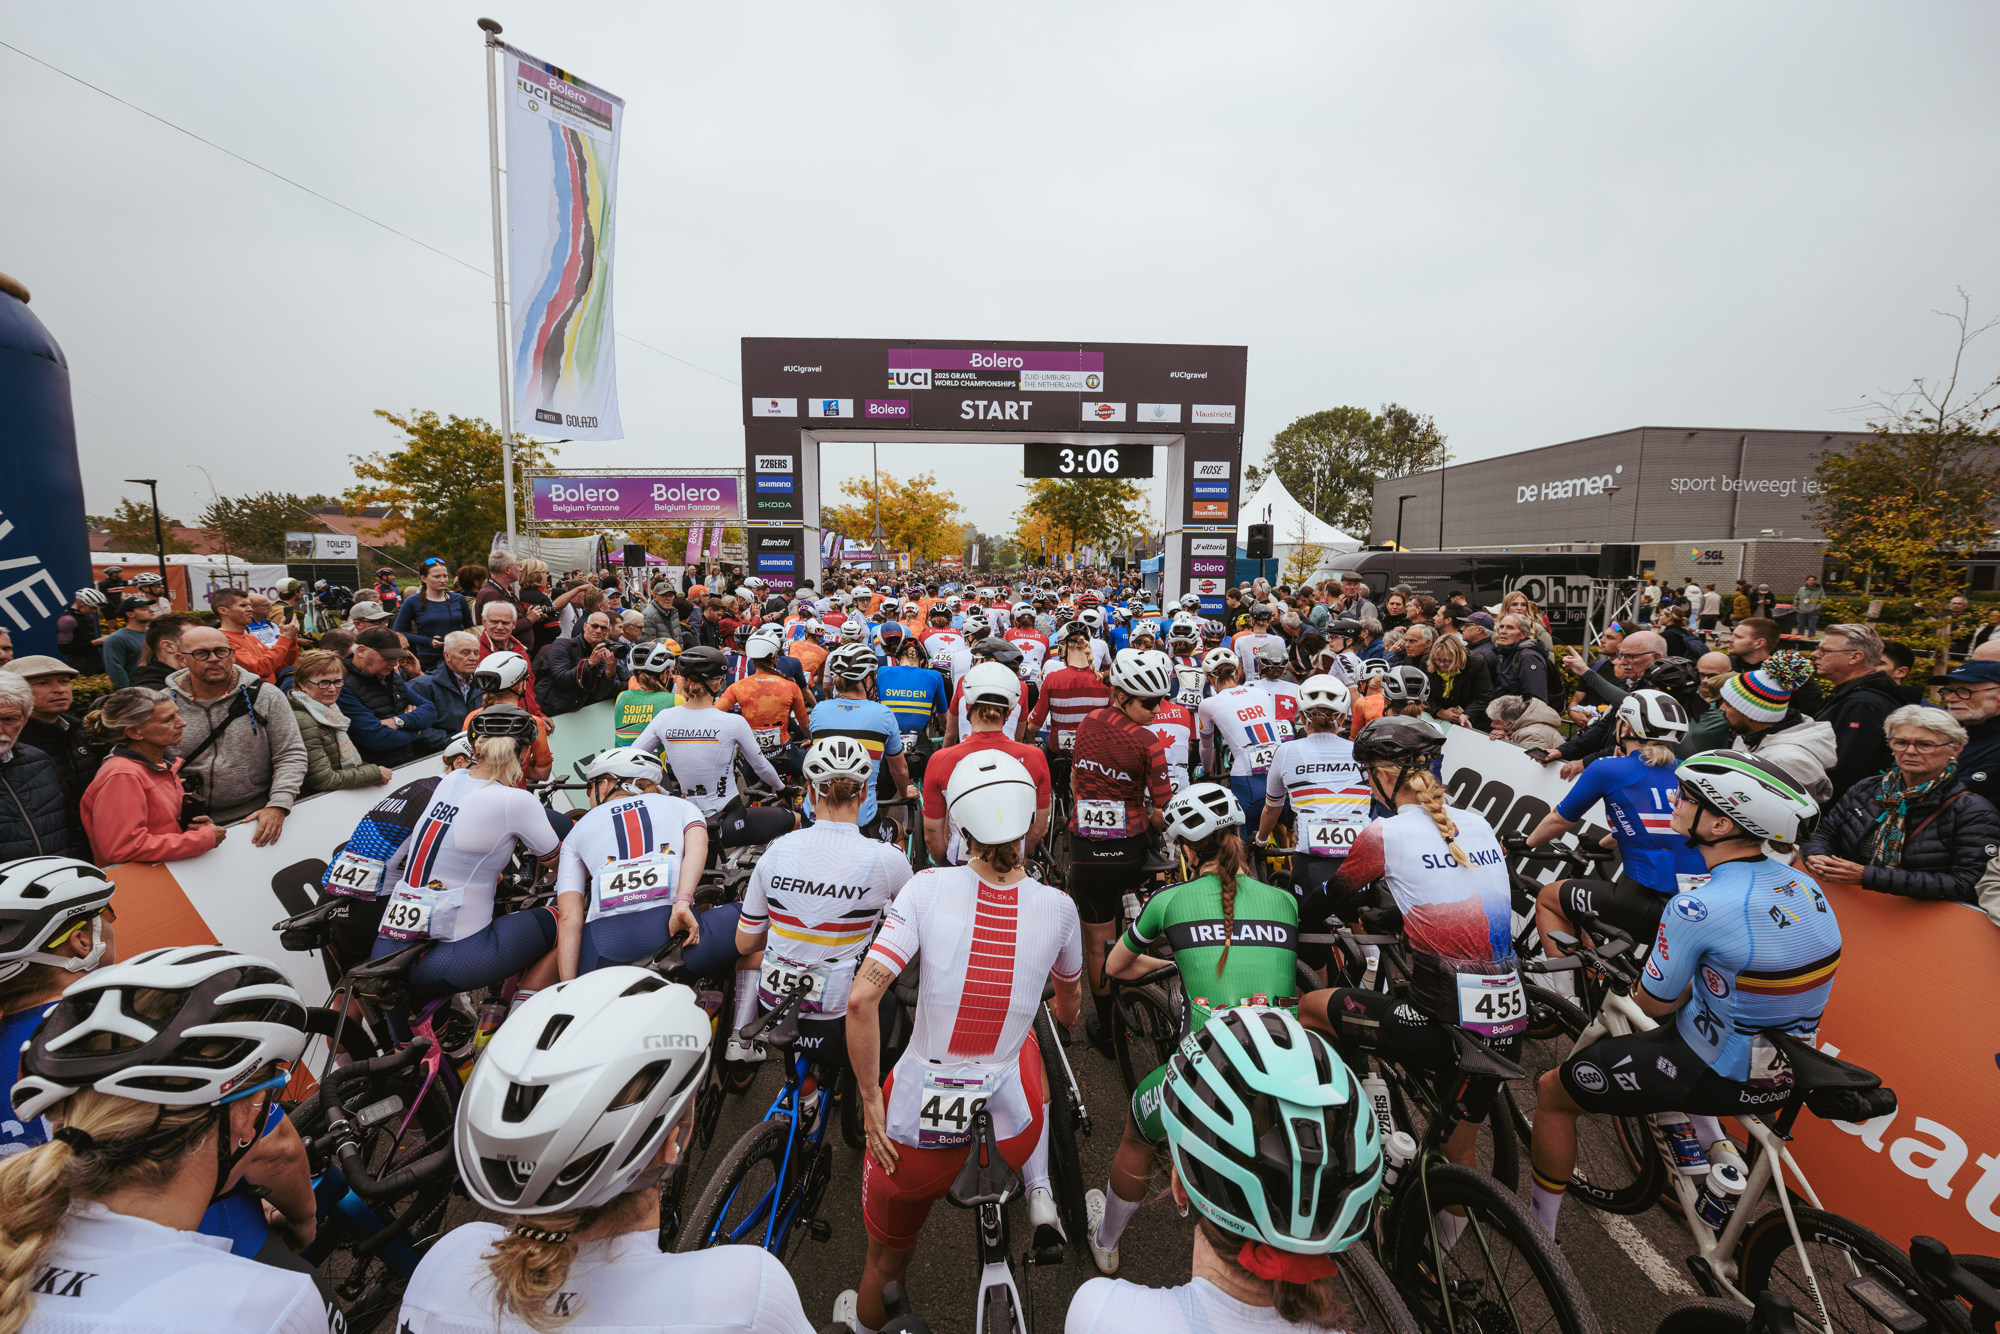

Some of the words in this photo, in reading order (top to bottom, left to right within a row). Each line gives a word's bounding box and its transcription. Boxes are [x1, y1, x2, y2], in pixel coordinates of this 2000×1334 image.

[522, 82, 548, 101] UCI
[547, 78, 587, 104] Bolero
[571, 108, 610, 129] CHAMPIONSHIPS
[969, 353, 1024, 368] Bolero
[783, 365, 822, 374] #UCIgravel
[1170, 371, 1208, 379] #UCIgravel
[896, 372, 928, 386] UCI
[960, 380, 1016, 388] CHAMPIONSHIPS
[868, 404, 905, 415] Bolero
[960, 400, 1033, 420] START
[1195, 410, 1232, 418] Maastricht
[566, 415, 598, 428] GOLAZO
[760, 459, 787, 469] 226ERS
[1058, 448, 1119, 473] 3:06
[1200, 465, 1224, 475] ROSE
[548, 483, 620, 502] Bolero
[650, 483, 721, 501] Bolero
[1670, 475, 1716, 494] sport
[1721, 475, 1797, 497] beweegt
[552, 504, 585, 513] Belgium
[586, 504, 620, 512] Fanzone
[654, 503, 686, 513] Belgium
[687, 503, 721, 511] Fanzone
[689, 520, 699, 545] Bole
[326, 540, 352, 549] TOILETS
[761, 538, 791, 546] Santini
[1704, 550, 1724, 560] SGL
[1193, 563, 1224, 572] Bolero
[1553, 611, 1560, 619] &
[1568, 610, 1586, 622] ligh
[1014, 632, 1041, 640] Canada
[885, 688, 927, 699] SWEDEN
[1180, 693, 1201, 704] 430
[624, 704, 654, 714] SOUTH
[1154, 709, 1182, 720] nada
[1236, 704, 1267, 722] GBR
[622, 714, 653, 724] AFRICA
[665, 728, 721, 738] GERMANY
[755, 735, 776, 746] 437
[1255, 750, 1273, 765] 43
[1074, 758, 1132, 782] ATVIA
[1295, 762, 1364, 775] GERMAN
[430, 801, 460, 823] GBR
[610, 800, 645, 815] GBR
[1168, 799, 1189, 811] KASK
[1696, 778, 1770, 835] SPECIALIZED
[1084, 809, 1117, 827] 443
[1215, 816, 1234, 826] KASK
[1610, 802, 1636, 837] ICELAND
[1316, 827, 1357, 844] 460
[1422, 848, 1502, 869] SLOAKIA
[333, 864, 370, 887] 447
[609, 867, 658, 893] 456
[770, 875, 872, 900] GERMANY
[981, 889, 1014, 900] POLSKA
[623, 893, 647, 903] Bolero
[1570, 886, 1598, 916] ISL
[387, 903, 421, 928] 439
[1768, 904, 1791, 929] EY
[1189, 924, 1288, 943] IRELAND
[1658, 922, 1670, 961] lotto
[766, 969, 814, 994] 459
[1475, 989, 1521, 1019] 455
[1491, 1024, 1514, 1035] Bolero
[643, 1034, 698, 1049] GIRO
[1166, 1063, 1178, 1085] ZER
[1613, 1072, 1642, 1091] EY
[1374, 1095, 1392, 1135] 226ERS
[938, 1134, 971, 1144] Bolero
[1211, 1209, 1246, 1233] Ramsay
